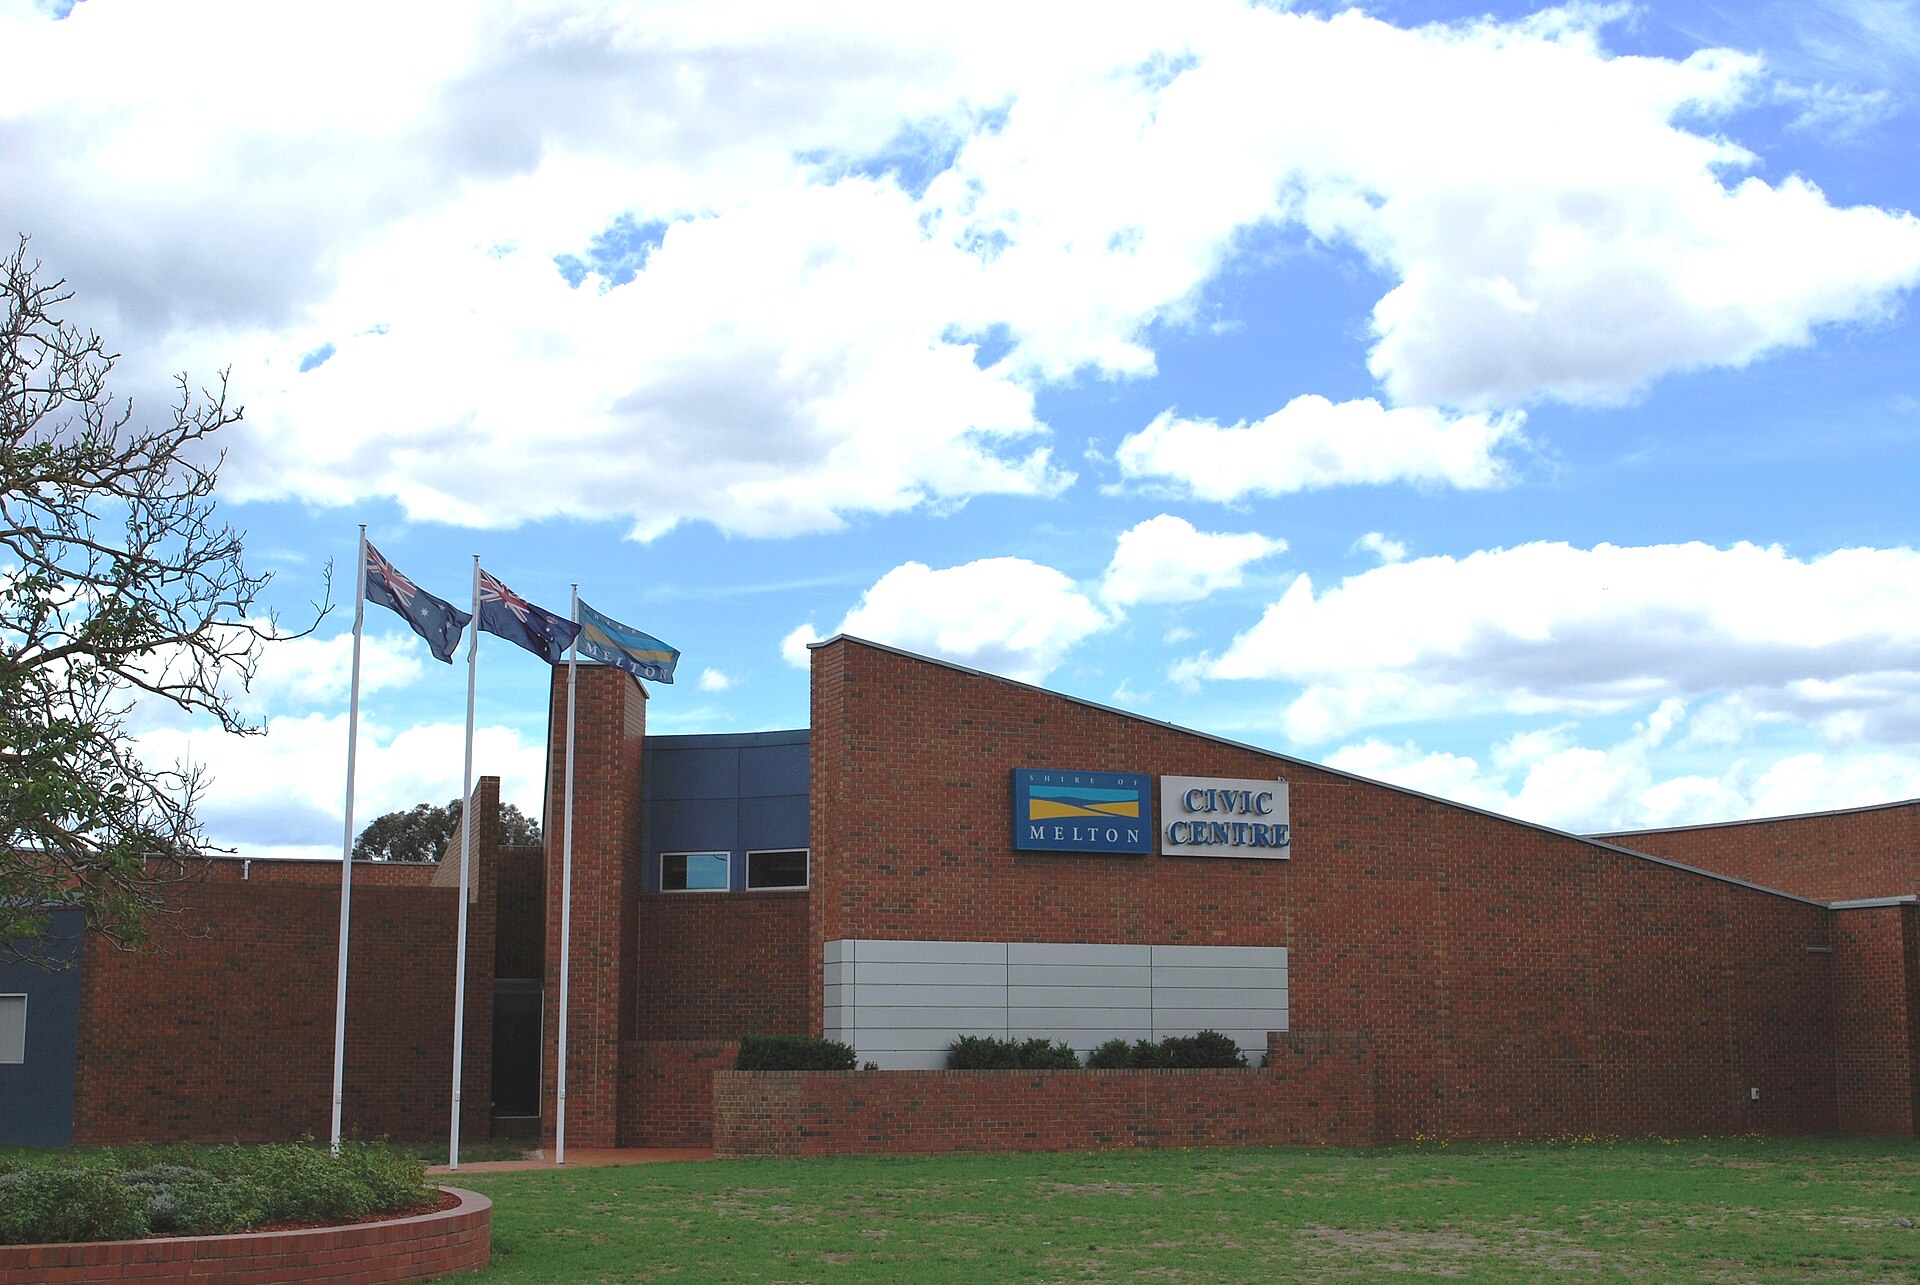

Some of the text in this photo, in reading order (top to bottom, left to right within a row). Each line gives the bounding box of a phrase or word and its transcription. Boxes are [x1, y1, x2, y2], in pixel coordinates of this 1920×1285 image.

[585, 642, 668, 680] MELTON
[1029, 774, 1095, 785] SHIRE
[1183, 788, 1274, 815] CIVIC
[1029, 825, 1140, 843] MELTON
[1168, 821, 1290, 848] CENTRE
